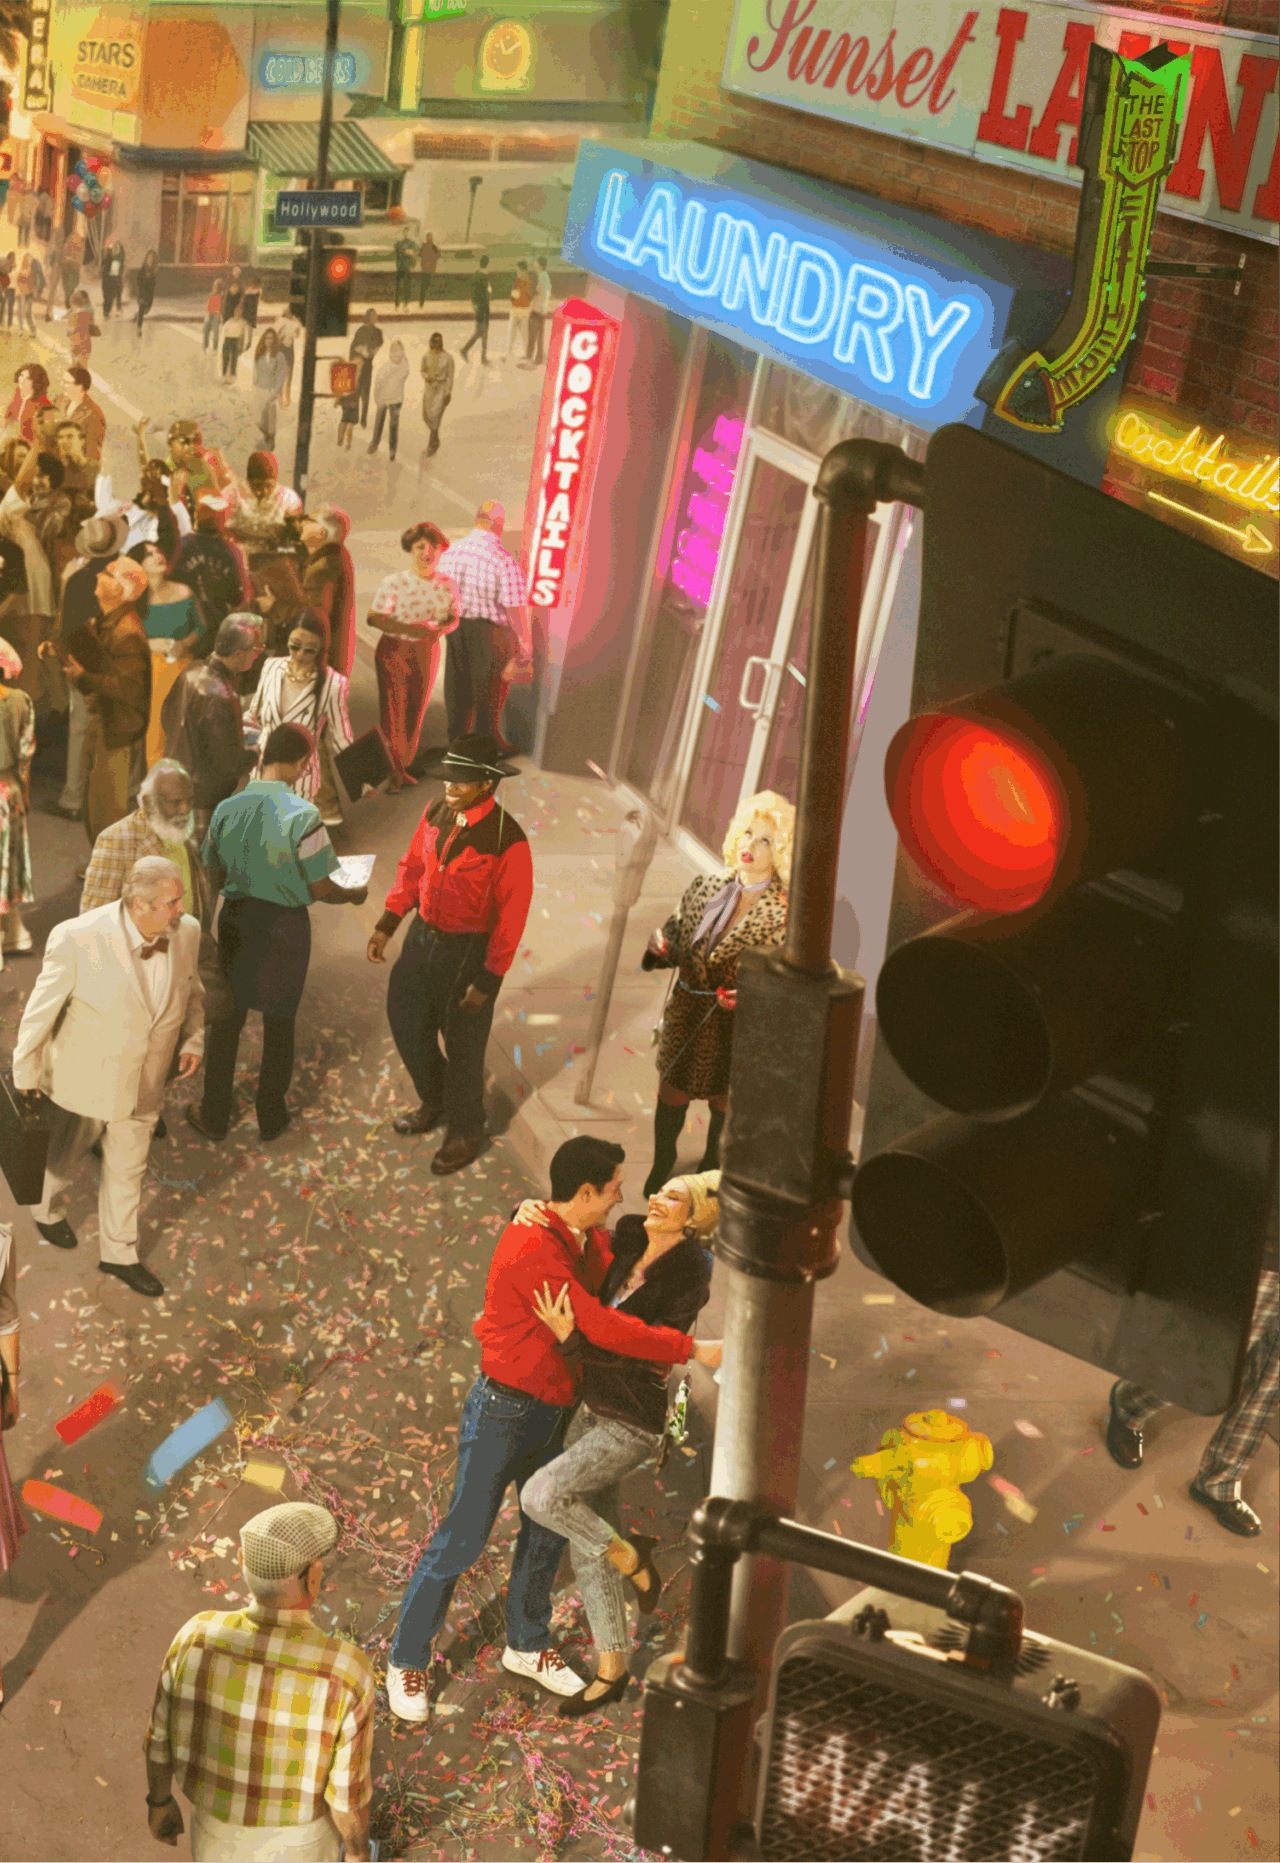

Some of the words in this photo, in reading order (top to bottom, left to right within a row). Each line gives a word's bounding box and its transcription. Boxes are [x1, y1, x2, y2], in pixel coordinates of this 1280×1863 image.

[77, 40, 135, 68] STARS
[77, 73, 128, 98] CAMERA
[746, 0, 978, 115] Sunset
[977, 7, 1280, 222] LAN
[1125, 94, 1166, 115] THE
[1120, 116, 1165, 138] LAST
[1118, 140, 1160, 174] STOP
[280, 201, 358, 221] Hollywood
[596, 170, 971, 401] LAUNDRY
[531, 330, 599, 607] COCKTAILS
